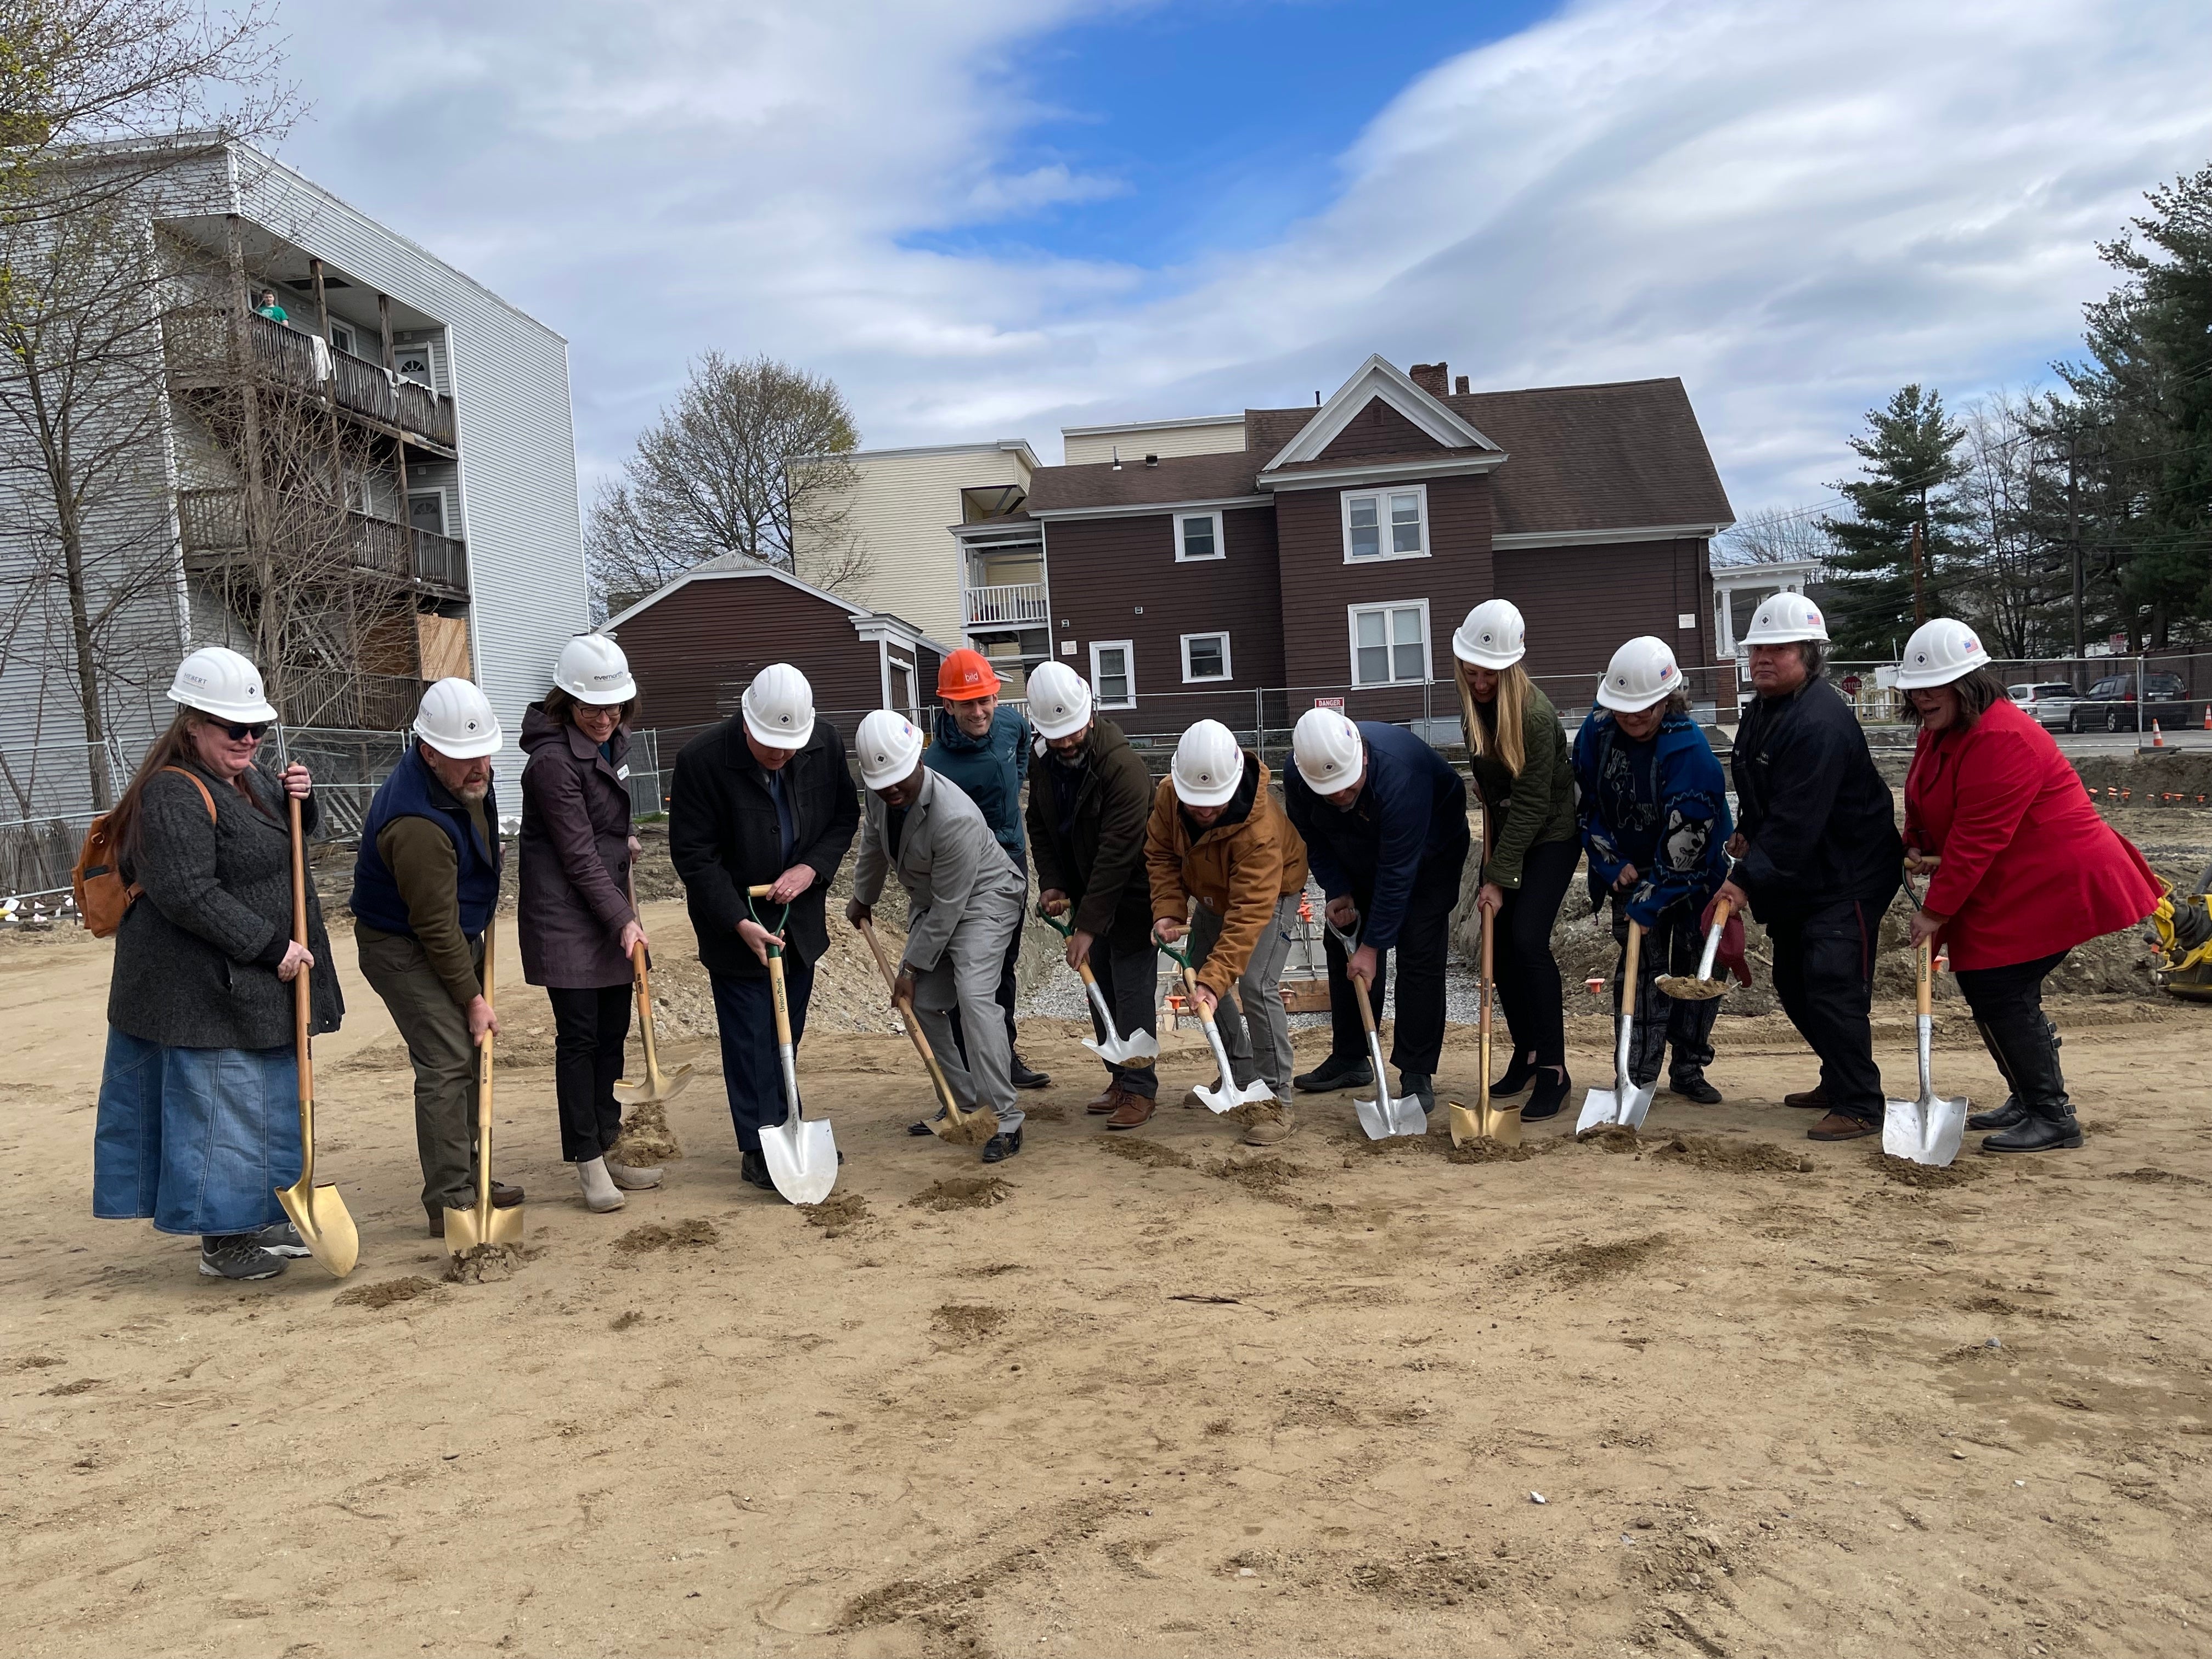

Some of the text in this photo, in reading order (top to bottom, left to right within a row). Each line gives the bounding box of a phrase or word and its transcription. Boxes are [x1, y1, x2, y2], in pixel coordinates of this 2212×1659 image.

[184, 673, 207, 685] HEBERT
[594, 670, 623, 680] evernorth
[965, 672, 979, 681] bild
[1843, 681, 1860, 690] STOP
[776, 978, 786, 1013] UnionTools
